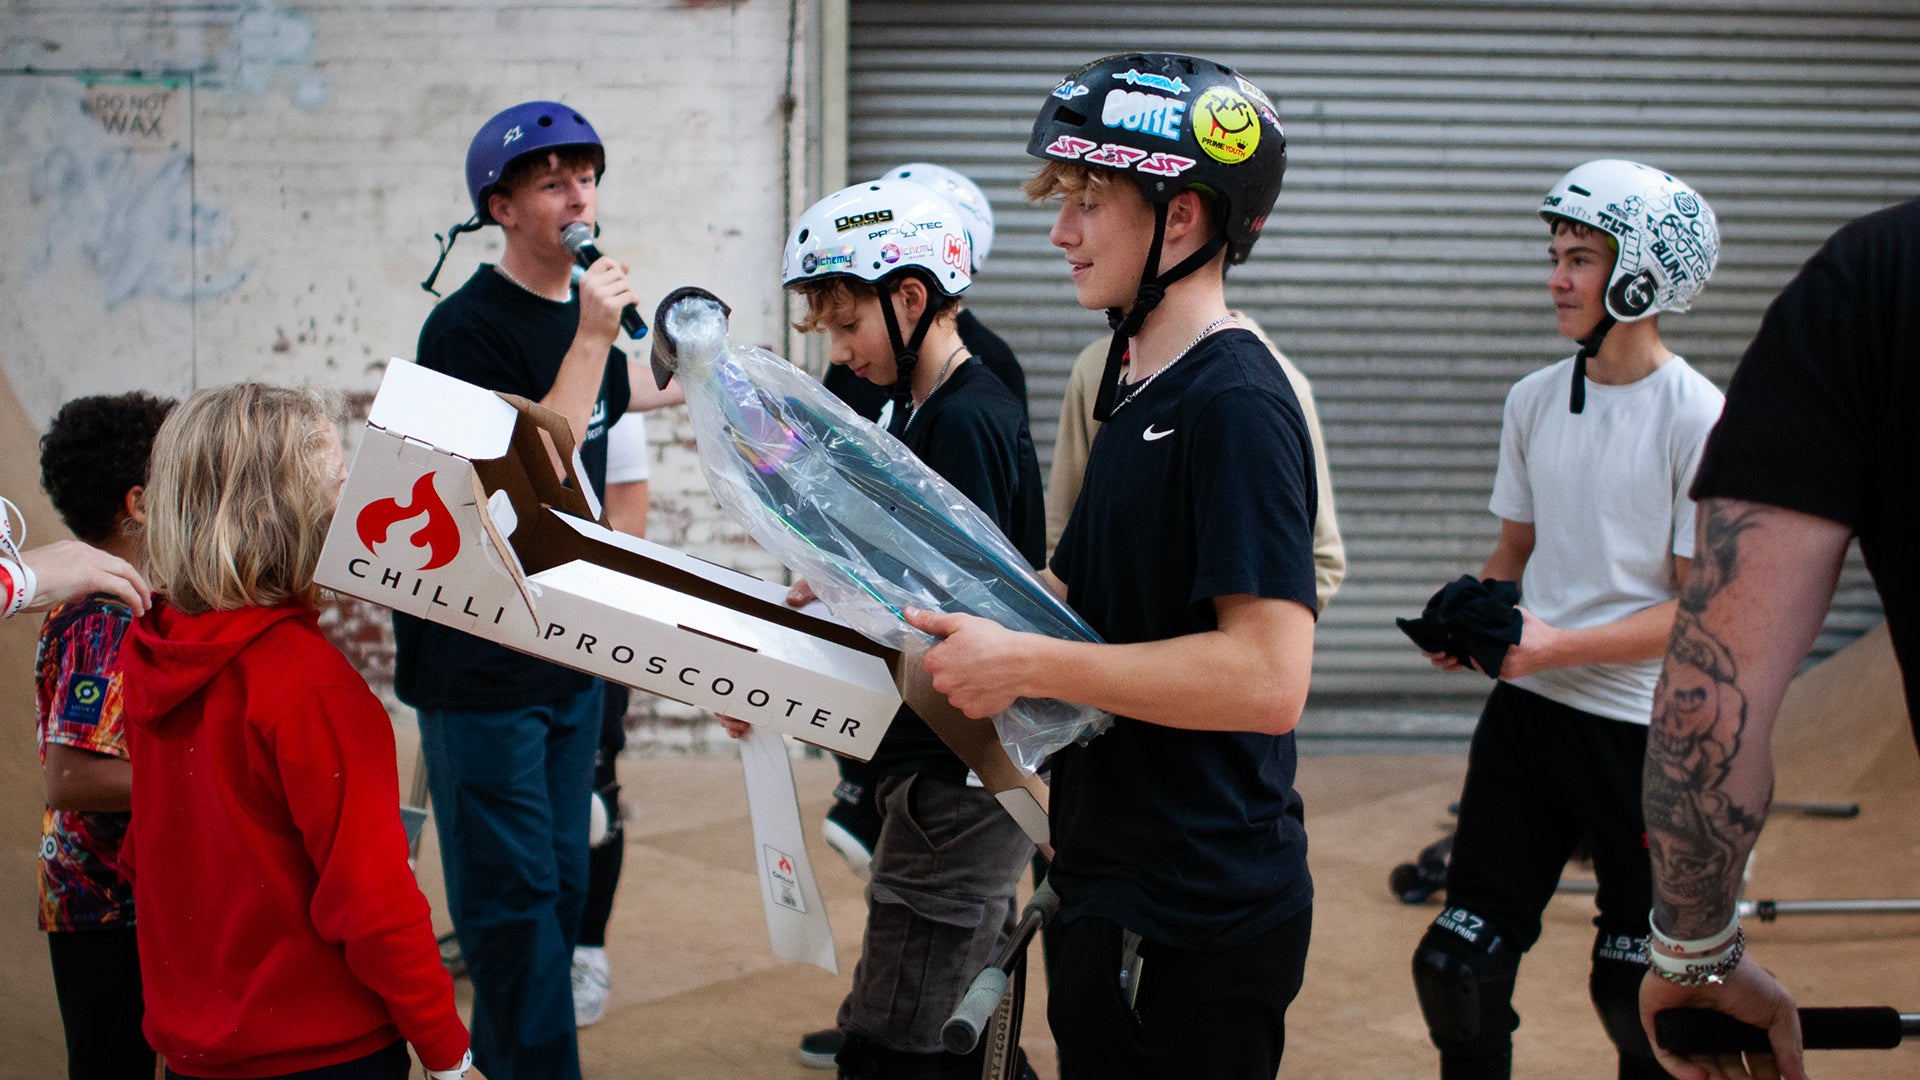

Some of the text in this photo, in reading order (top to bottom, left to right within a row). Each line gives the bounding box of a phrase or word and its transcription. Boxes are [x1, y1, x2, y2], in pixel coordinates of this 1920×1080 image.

[130, 92, 169, 110] NOT
[102, 112, 162, 138] WAX
[1650, 239, 1689, 286] BLUNT
[349, 557, 504, 625] CHILLI
[544, 622, 863, 739] PROSCOOTER
[1444, 907, 1484, 930] 187
[1603, 933, 1646, 952] 187
